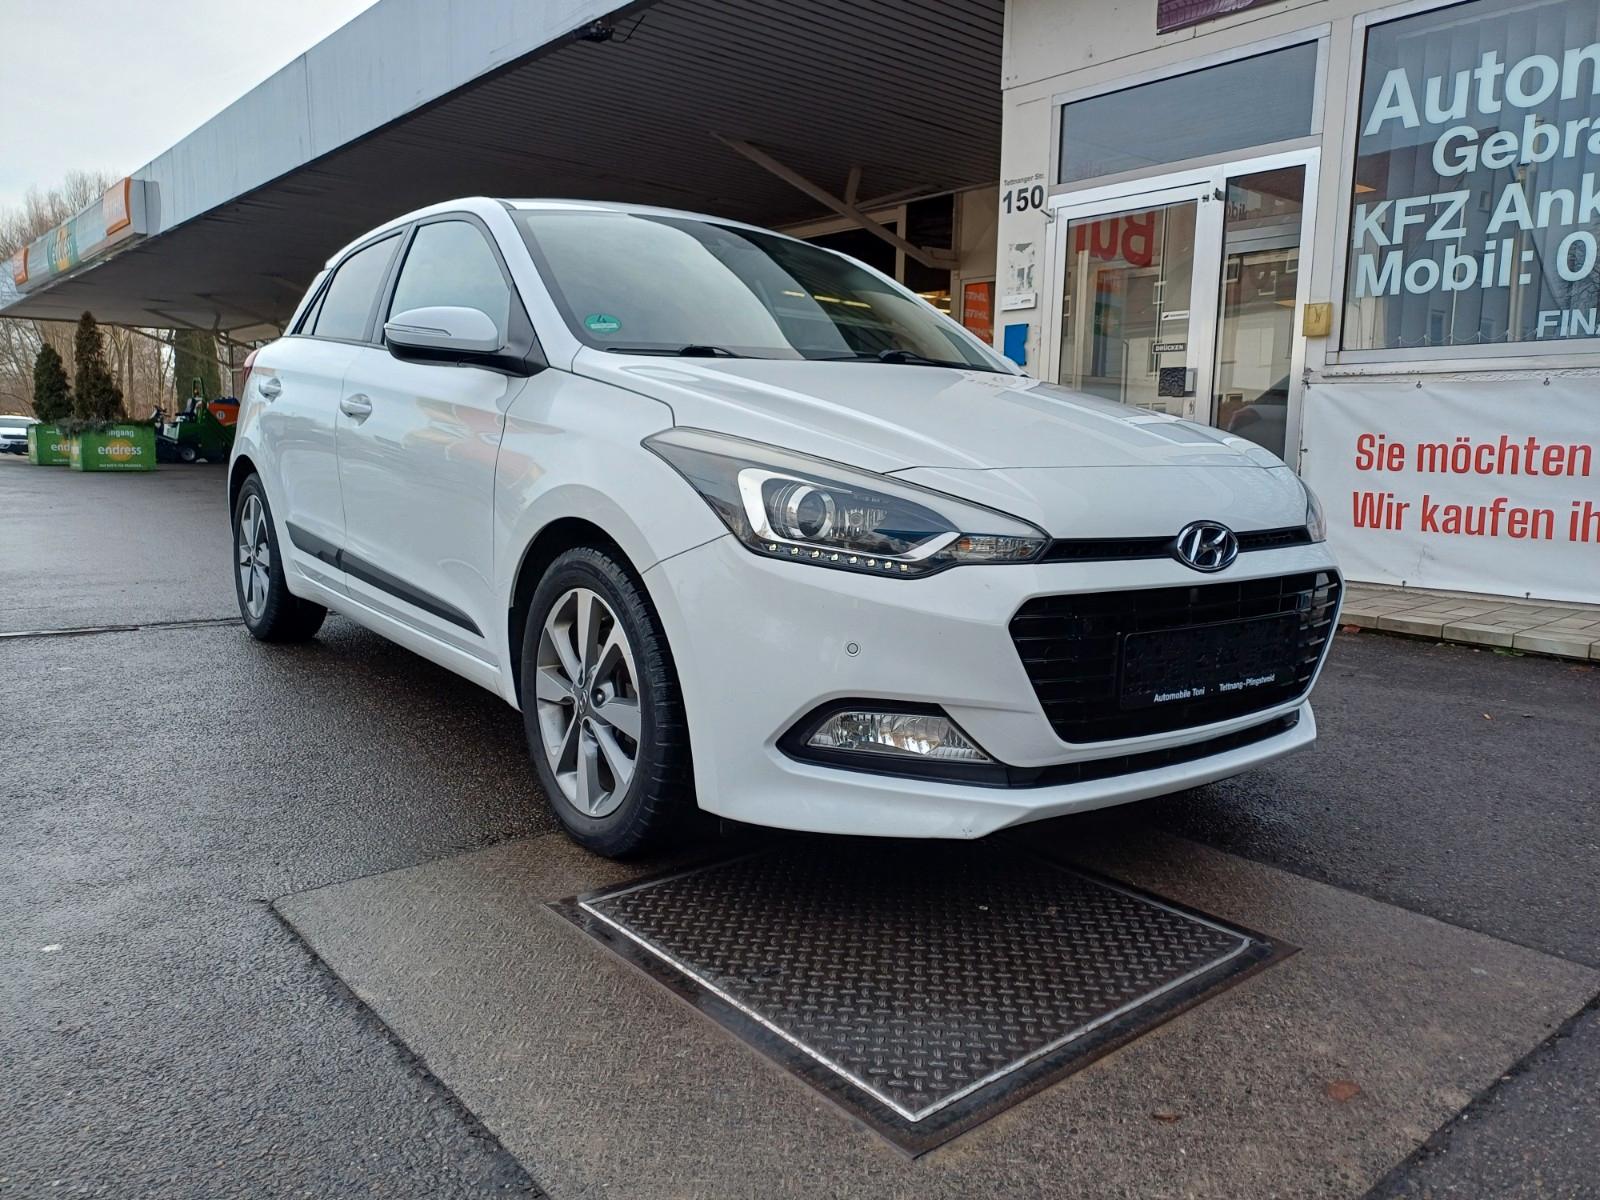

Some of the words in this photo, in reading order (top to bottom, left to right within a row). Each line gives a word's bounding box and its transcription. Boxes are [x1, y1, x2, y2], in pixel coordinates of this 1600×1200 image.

[1003, 184, 1044, 214] 150
[1353, 189, 1471, 249] KFZ
[1355, 238, 1534, 298] Mobil:
[1556, 230, 1598, 282] 0
[1536, 307, 1600, 338] FIN
[1155, 343, 1184, 352] DRÜCKEN
[97, 444, 142, 455] endress
[1355, 433, 1405, 472] Sie
[1417, 435, 1592, 477] möchten
[1353, 491, 1411, 531] Wir
[1420, 494, 1555, 540] kaufen
[1153, 689, 1191, 702] Automobile
[1192, 687, 1205, 697] Toni
